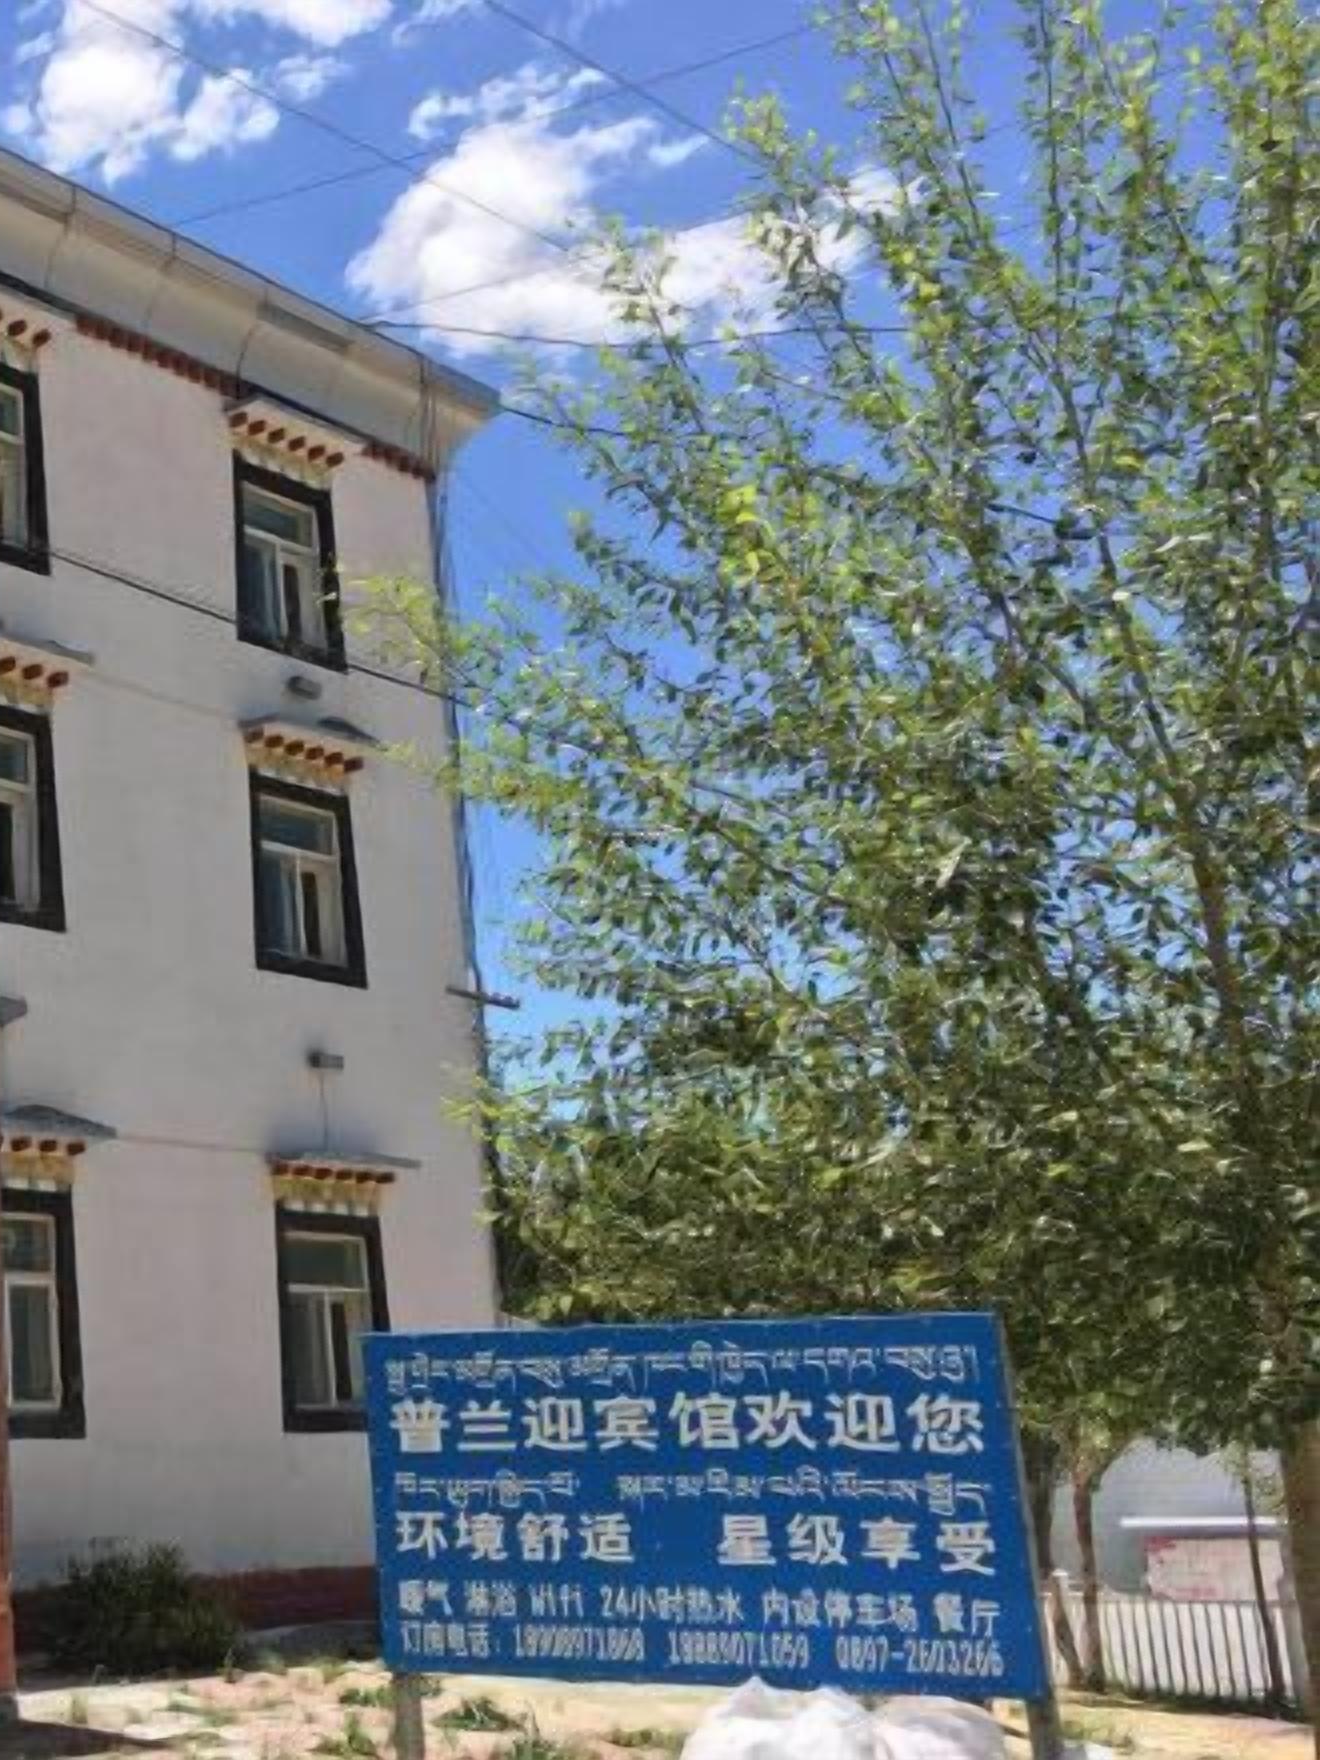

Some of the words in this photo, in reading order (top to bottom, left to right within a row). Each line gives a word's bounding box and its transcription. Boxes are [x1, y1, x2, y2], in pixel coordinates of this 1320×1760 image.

[389, 1390, 985, 1454] 普兰迎宾馆欢迎您
[394, 1511, 635, 1563] 环境舒适
[716, 1513, 996, 1576] 星级享受
